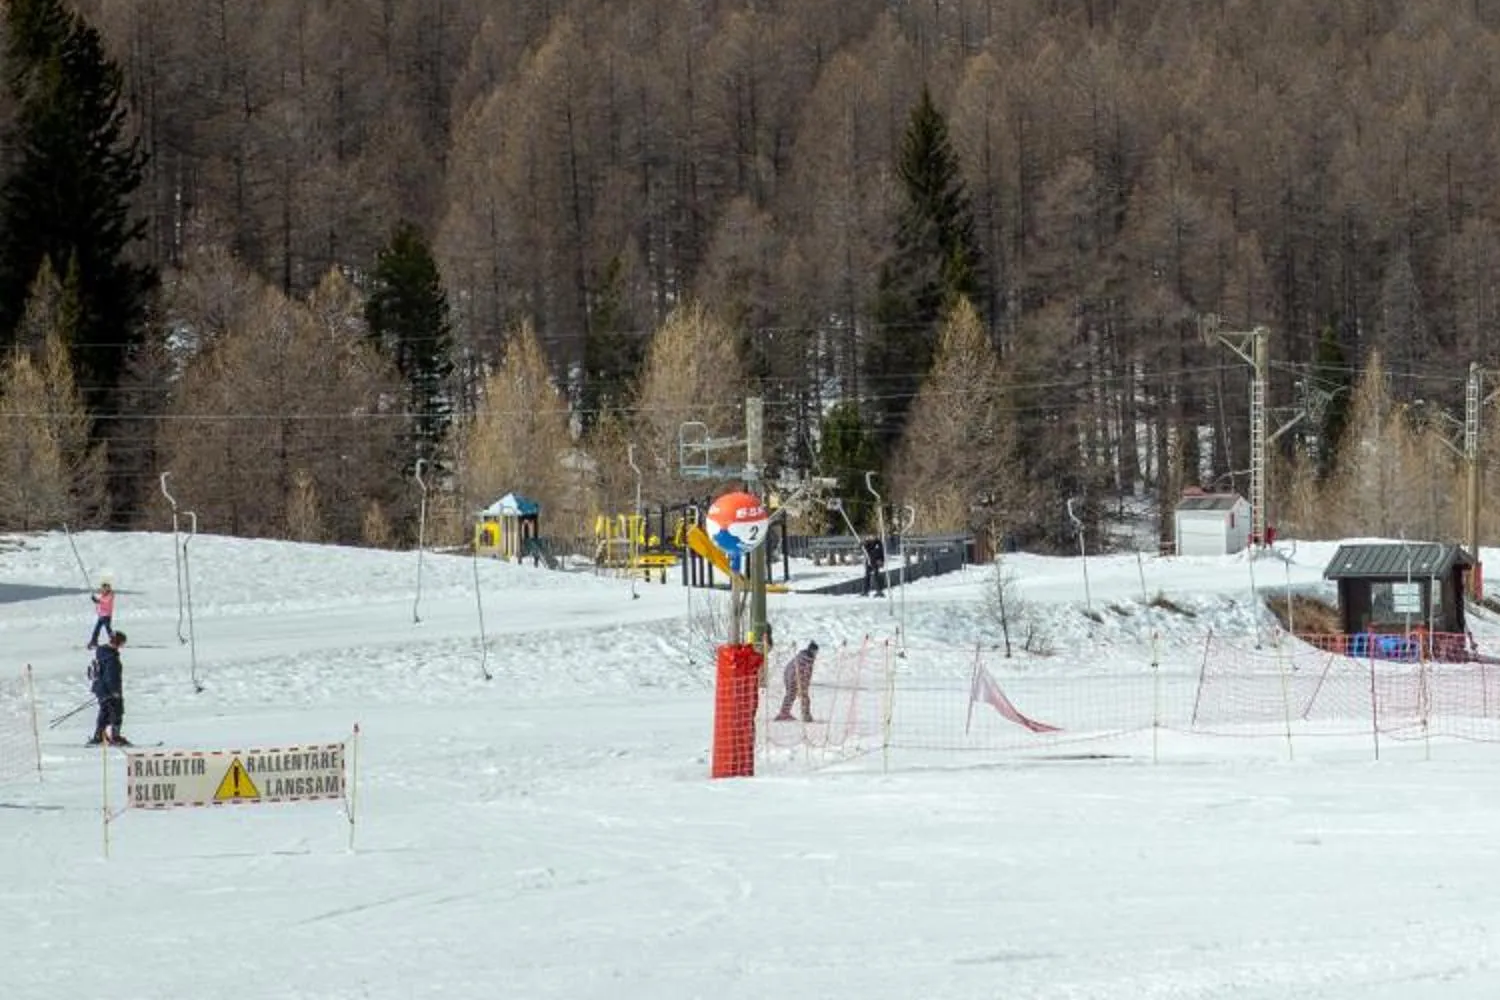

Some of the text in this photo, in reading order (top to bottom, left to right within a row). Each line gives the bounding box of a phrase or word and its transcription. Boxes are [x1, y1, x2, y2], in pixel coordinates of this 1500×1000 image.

[749, 525, 759, 541] 2
[134, 758, 205, 777] RALENTIR
[247, 751, 339, 773] RALLENTARE
[135, 783, 176, 802] SLOW
[265, 776, 339, 797] LANGSAM
